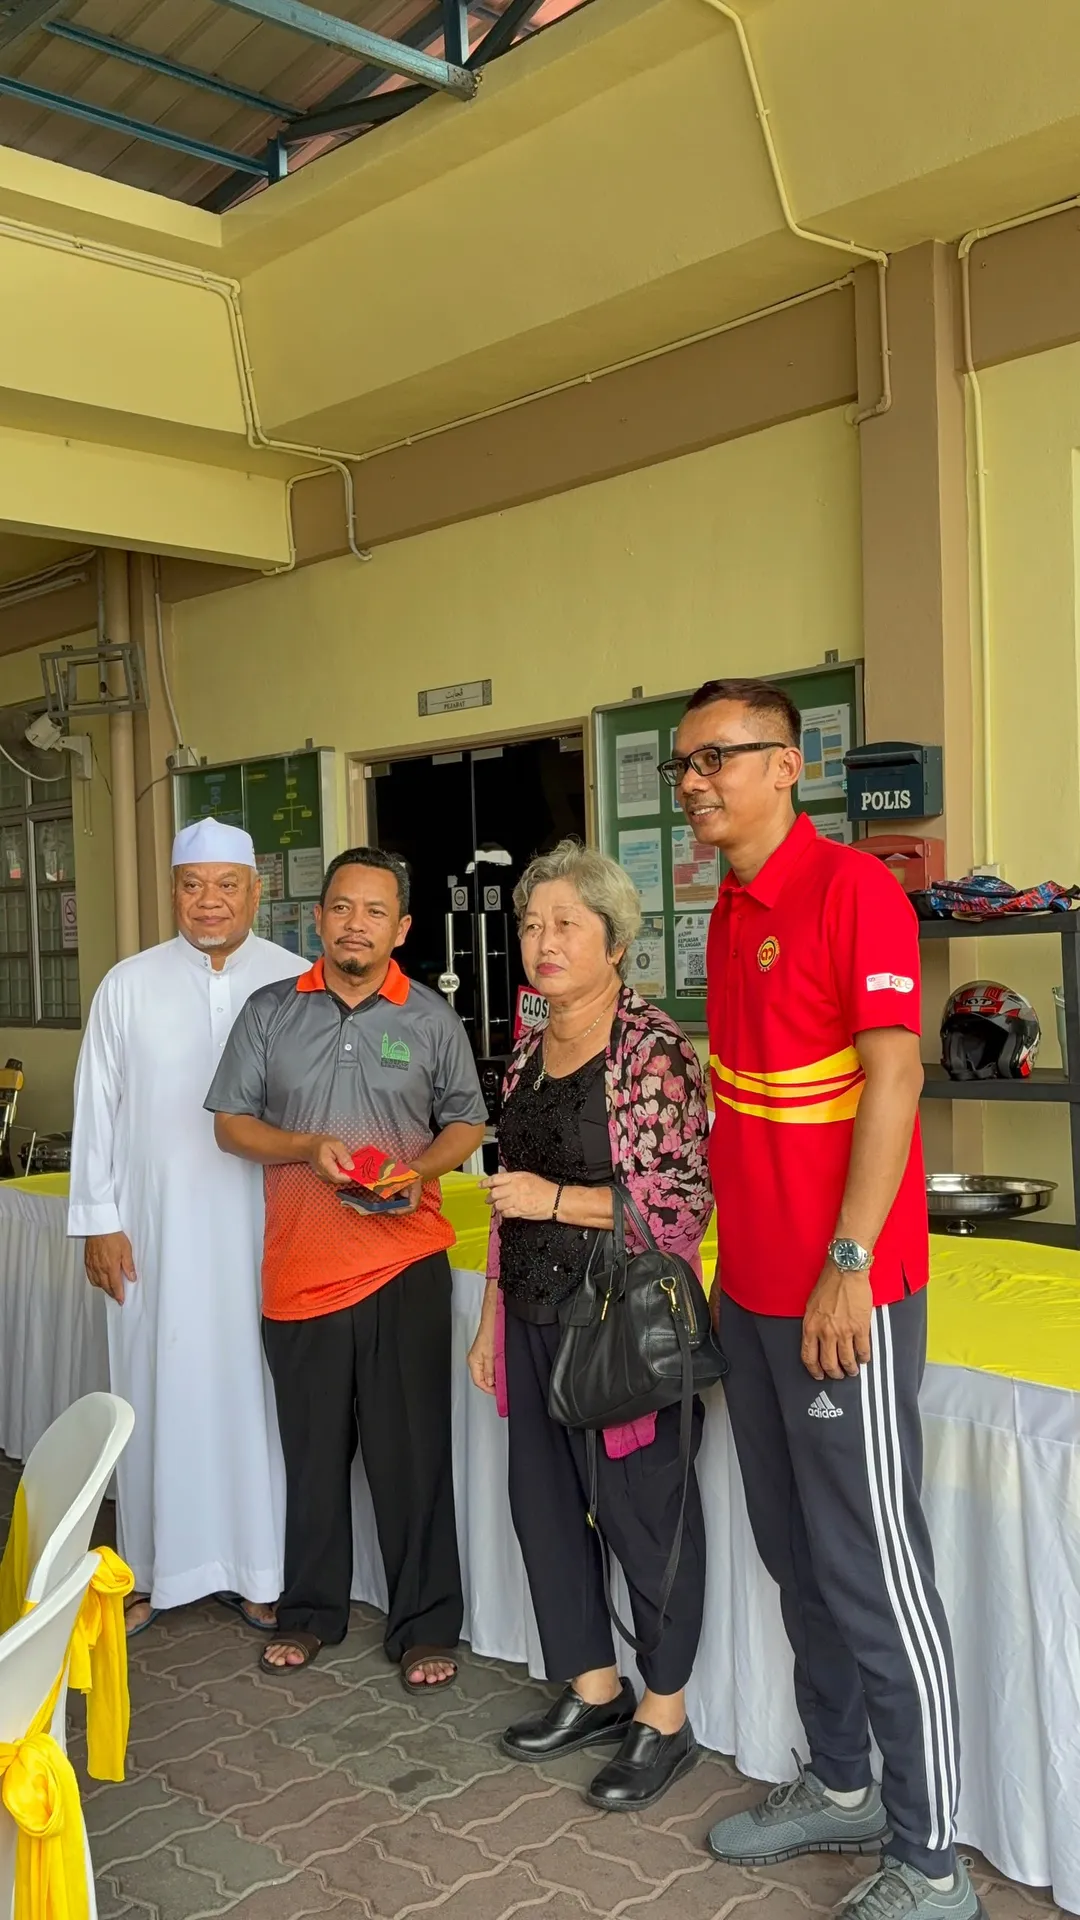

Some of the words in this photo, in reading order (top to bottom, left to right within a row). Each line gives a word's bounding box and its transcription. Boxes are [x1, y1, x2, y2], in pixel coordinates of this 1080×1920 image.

[443, 701, 466, 710] PEJABAT
[861, 790, 911, 811] POLIS
[522, 994, 548, 1019] CLOS
[964, 998, 989, 1006] KYT
[808, 1408, 843, 1418] adidas
